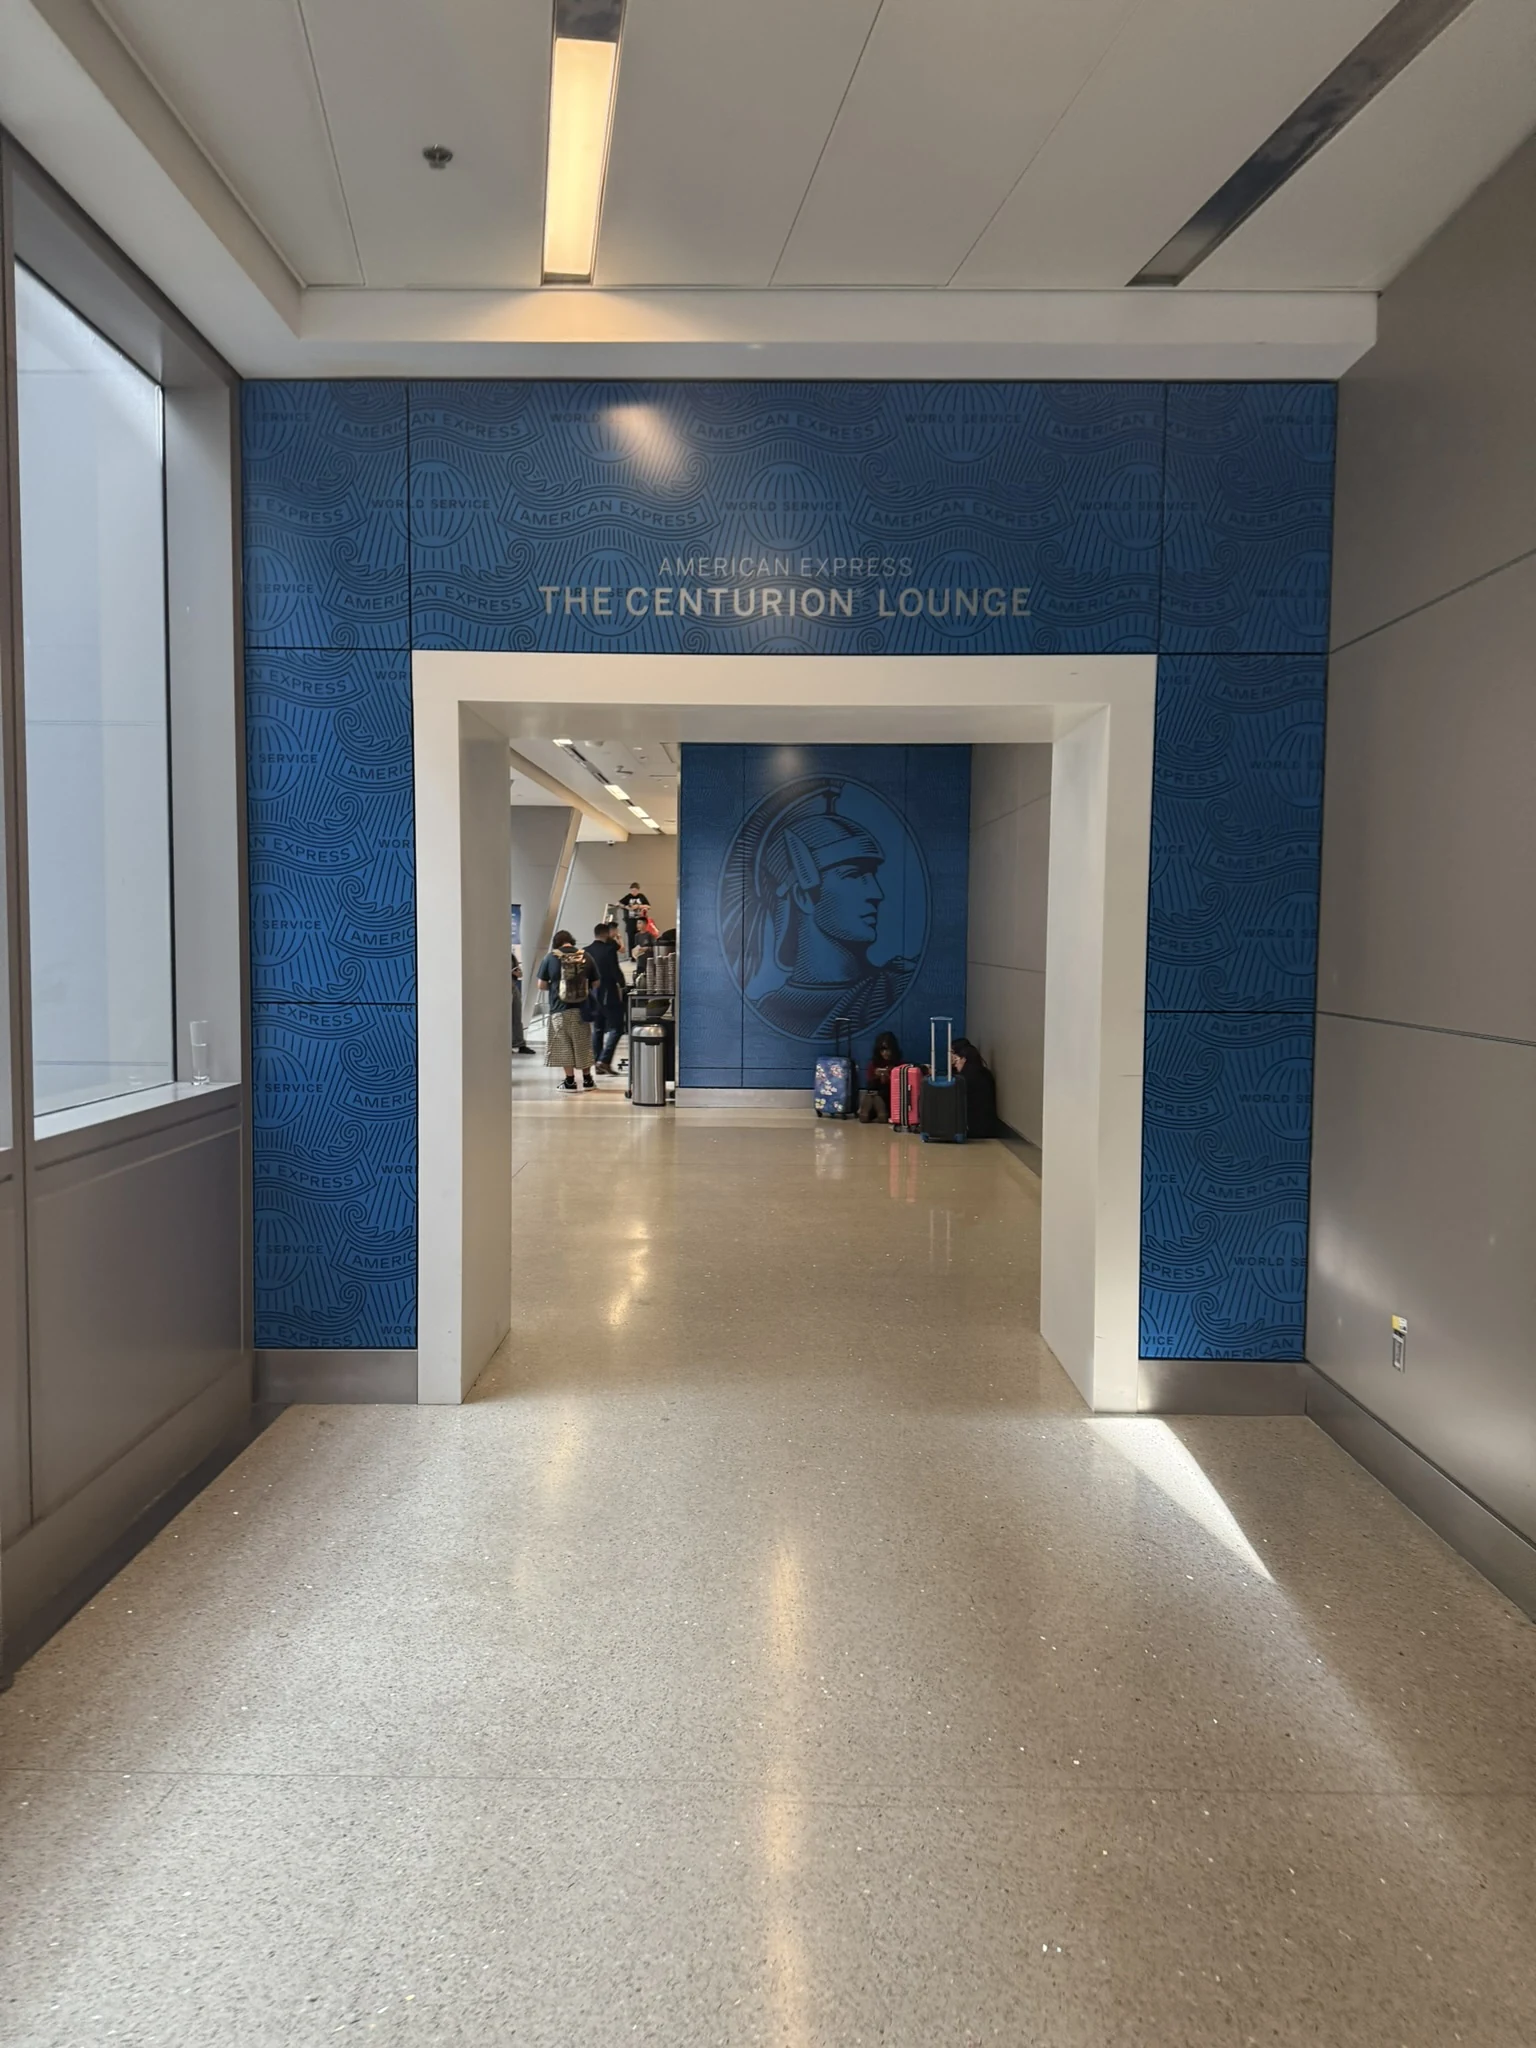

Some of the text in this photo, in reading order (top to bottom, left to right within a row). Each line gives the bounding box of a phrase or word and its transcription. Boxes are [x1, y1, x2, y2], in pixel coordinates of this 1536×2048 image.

[341, 412, 521, 438] AMERICAN EXPRESS
[696, 412, 874, 439] AMERICAN EXPRESS
[905, 414, 1022, 423] WORLD SERVICE
[1051, 414, 1232, 440] AMERICAN EXPRESS
[1263, 414, 1313, 424] WORLD
[267, 500, 343, 523] EXPRESS
[371, 499, 490, 509] WORLD SERVICE
[520, 501, 697, 526] AMERICAN EXPRESS
[725, 501, 842, 511] WORLD SERVICE
[871, 502, 1052, 528] AMERICAN EXPRESS
[1080, 501, 1198, 511] WORLD SERVICE
[1228, 502, 1322, 527] AMERICAN
[658, 557, 912, 576] AMERICAN EXPRESS
[255, 583, 314, 594] SERVICE
[343, 585, 438, 610] AMERICAN
[446, 586, 522, 611] EXPRESS
[1047, 587, 1139, 612] AMERICAN
[1148, 588, 1226, 612] EXPRESS
[1256, 588, 1307, 598] WORLD
[538, 585, 613, 616] THE
[625, 588, 853, 617] CENTURION
[878, 587, 1032, 617] LOUNGE
[271, 670, 347, 694] EXPRESS
[1221, 675, 1315, 700] AMERICAN
[259, 754, 317, 764] SERVICE
[1250, 760, 1299, 770] WORLD
[274, 838, 350, 862] EXPRESS
[1216, 844, 1309, 869] AMERICAN
[262, 920, 321, 930] SERVICE
[1243, 928, 1294, 938] WORLD
[278, 1004, 353, 1027] EXPRESS
[1210, 1014, 1303, 1035] AMERICAN
[265, 1084, 323, 1093] SERVICE
[1239, 1093, 1289, 1103] WORLD
[278, 1165, 353, 1188] EXPRESS
[1207, 1175, 1299, 1199] AMERICAN
[266, 1245, 324, 1254] SERVICE
[1234, 1257, 1284, 1267] WORLD
